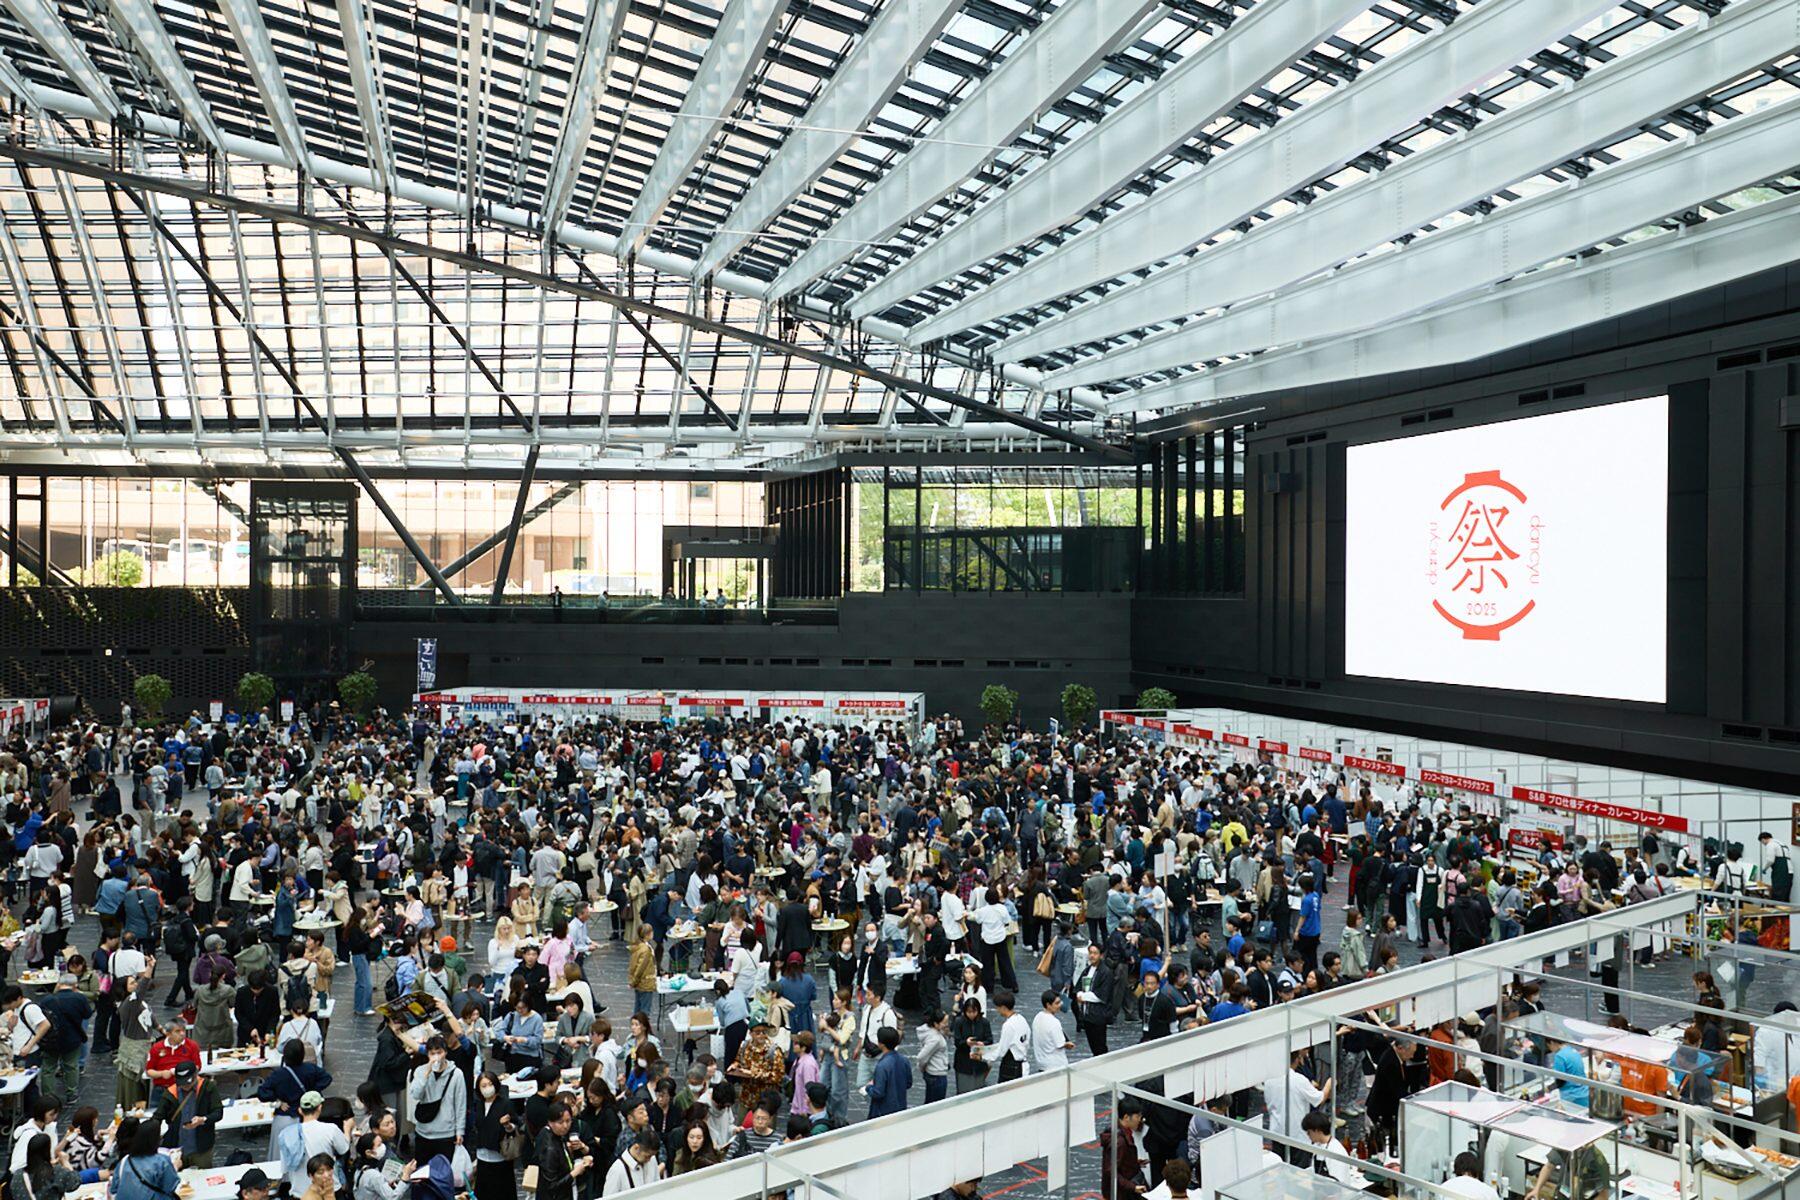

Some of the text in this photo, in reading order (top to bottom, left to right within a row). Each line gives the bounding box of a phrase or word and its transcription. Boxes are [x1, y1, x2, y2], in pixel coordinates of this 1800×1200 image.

[1425, 522, 1441, 585] dancyu
[1445, 499, 1520, 594] 祭
[1527, 514, 1545, 584] dancyu
[1466, 602, 1497, 616] 2025
[1528, 791, 1666, 825] S&B プロ仕様ディナーカレーフレーク
